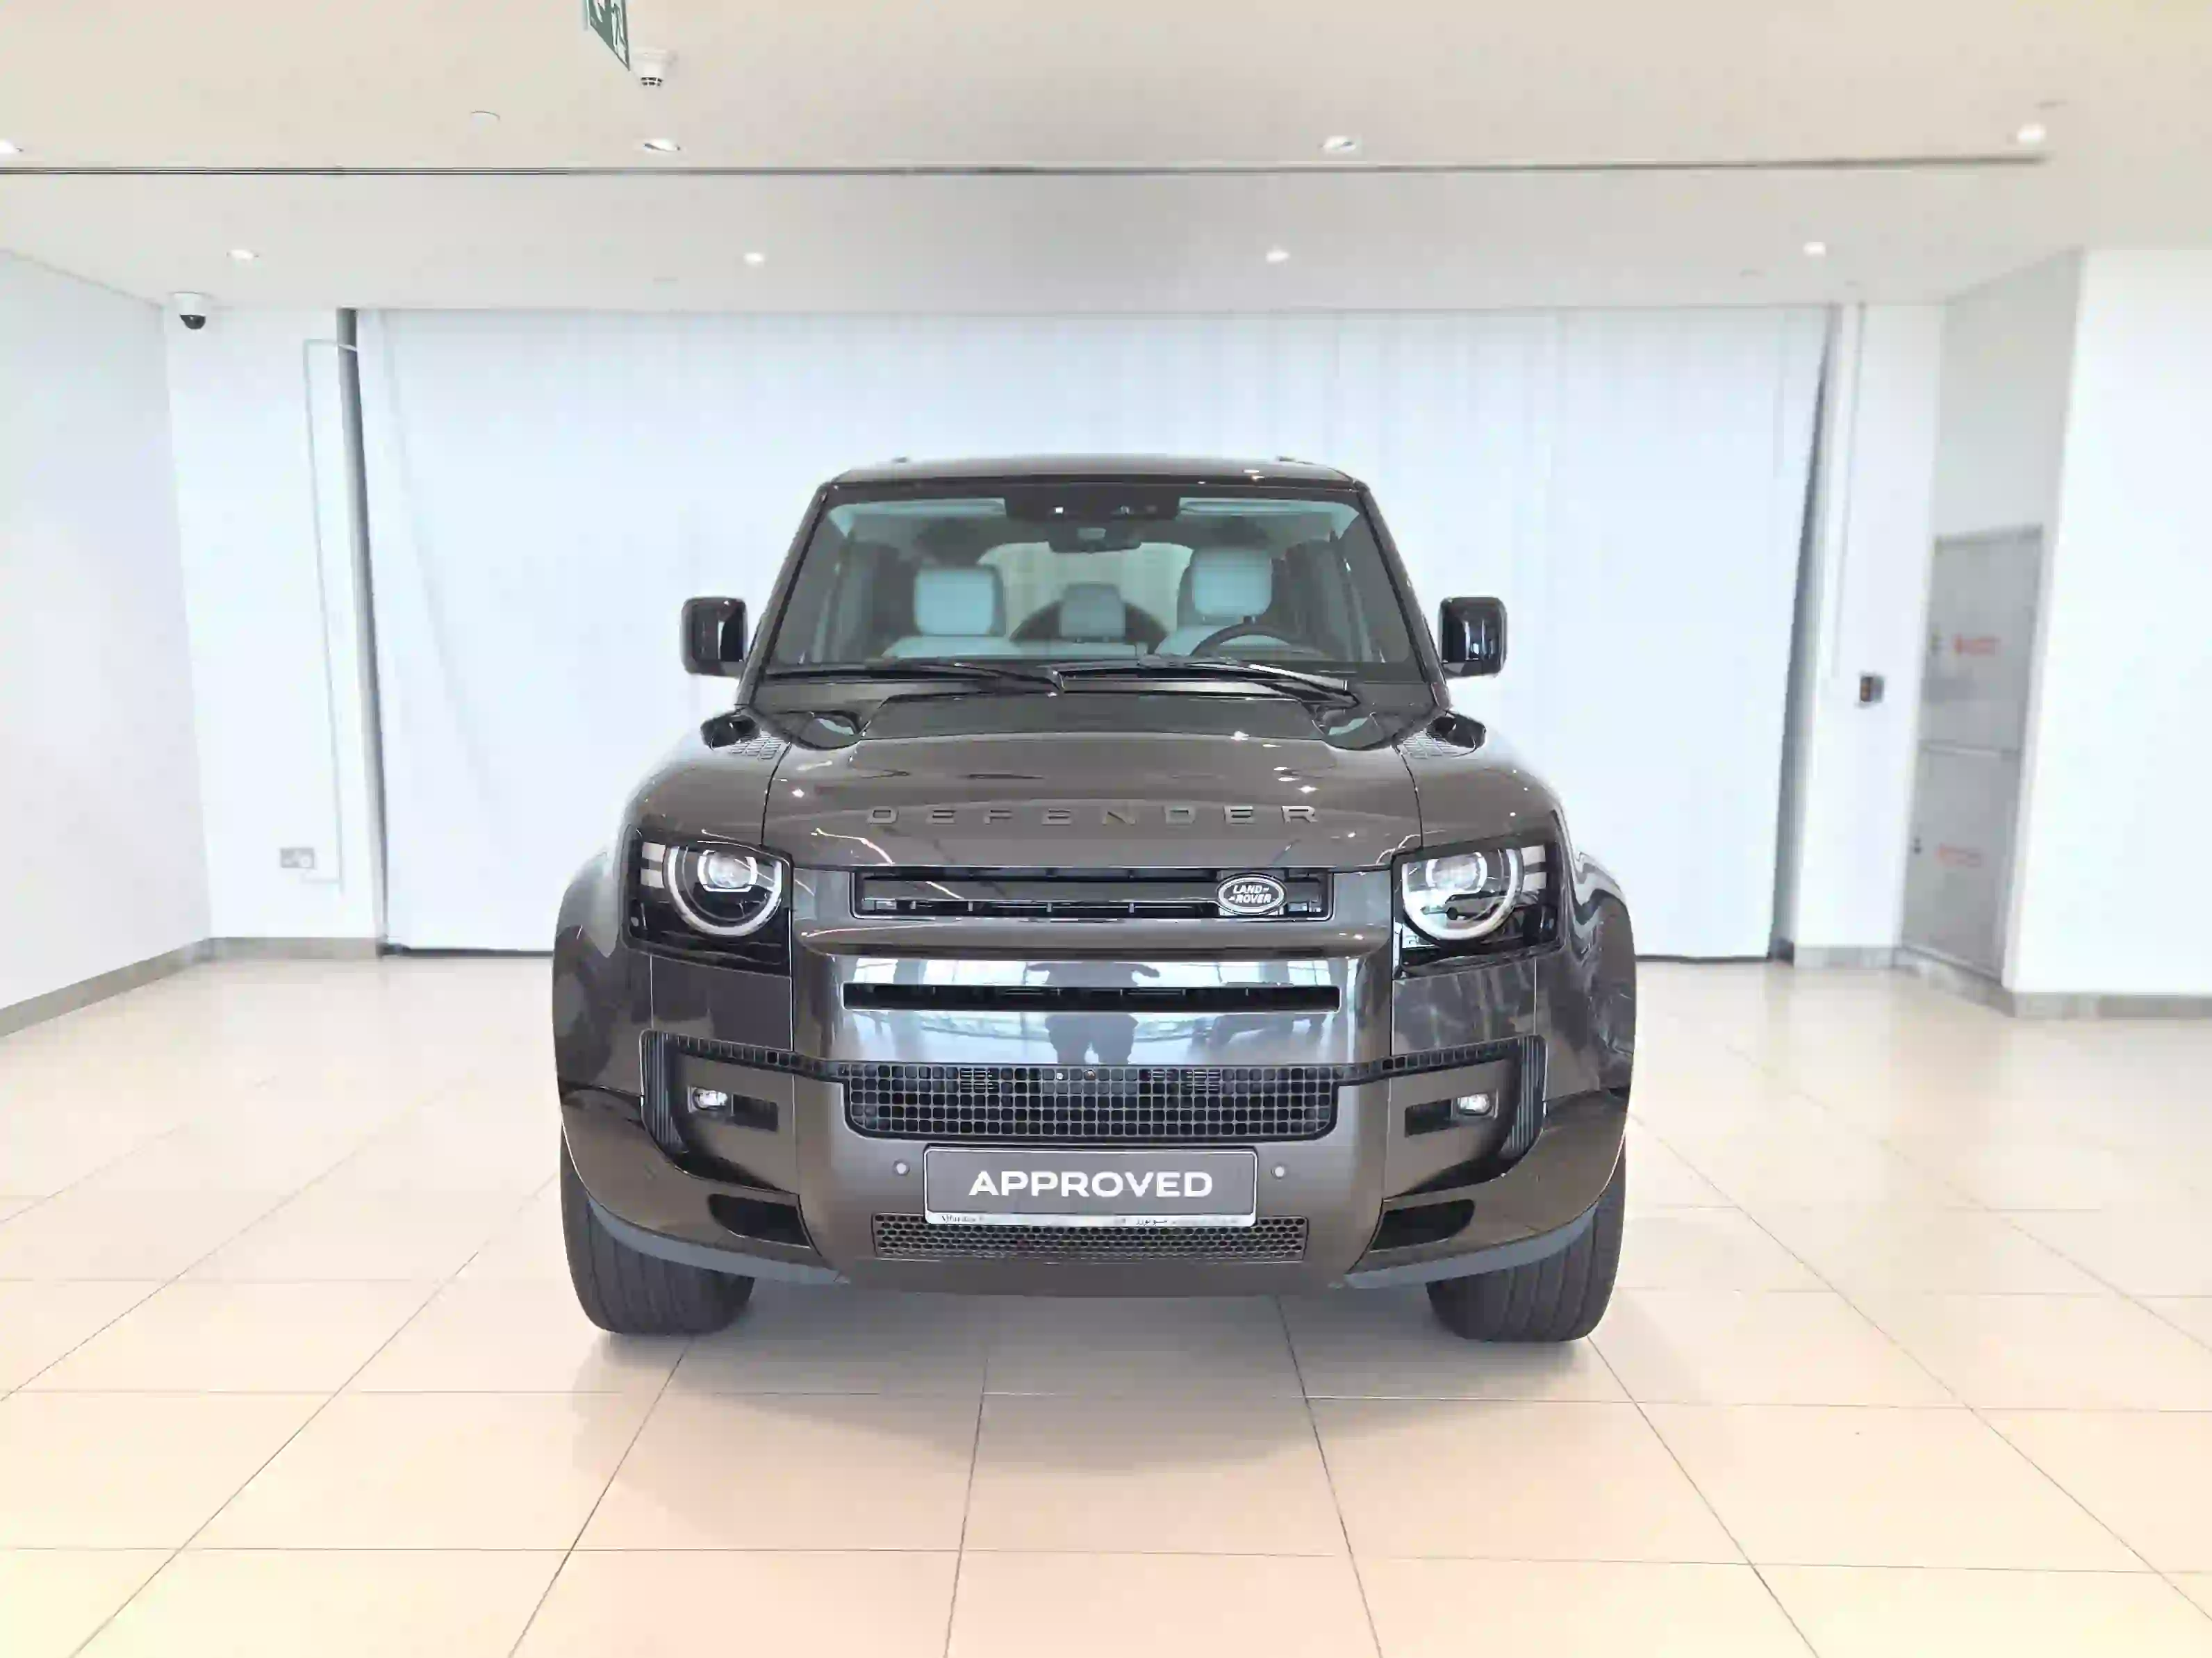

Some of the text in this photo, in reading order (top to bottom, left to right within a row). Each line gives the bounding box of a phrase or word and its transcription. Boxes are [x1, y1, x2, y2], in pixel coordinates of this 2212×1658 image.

[867, 805, 1319, 826] DEFENDER
[1233, 885, 1263, 894] LAND
[1235, 894, 1272, 903] ROVER
[968, 1170, 1213, 1197] APPROVED
